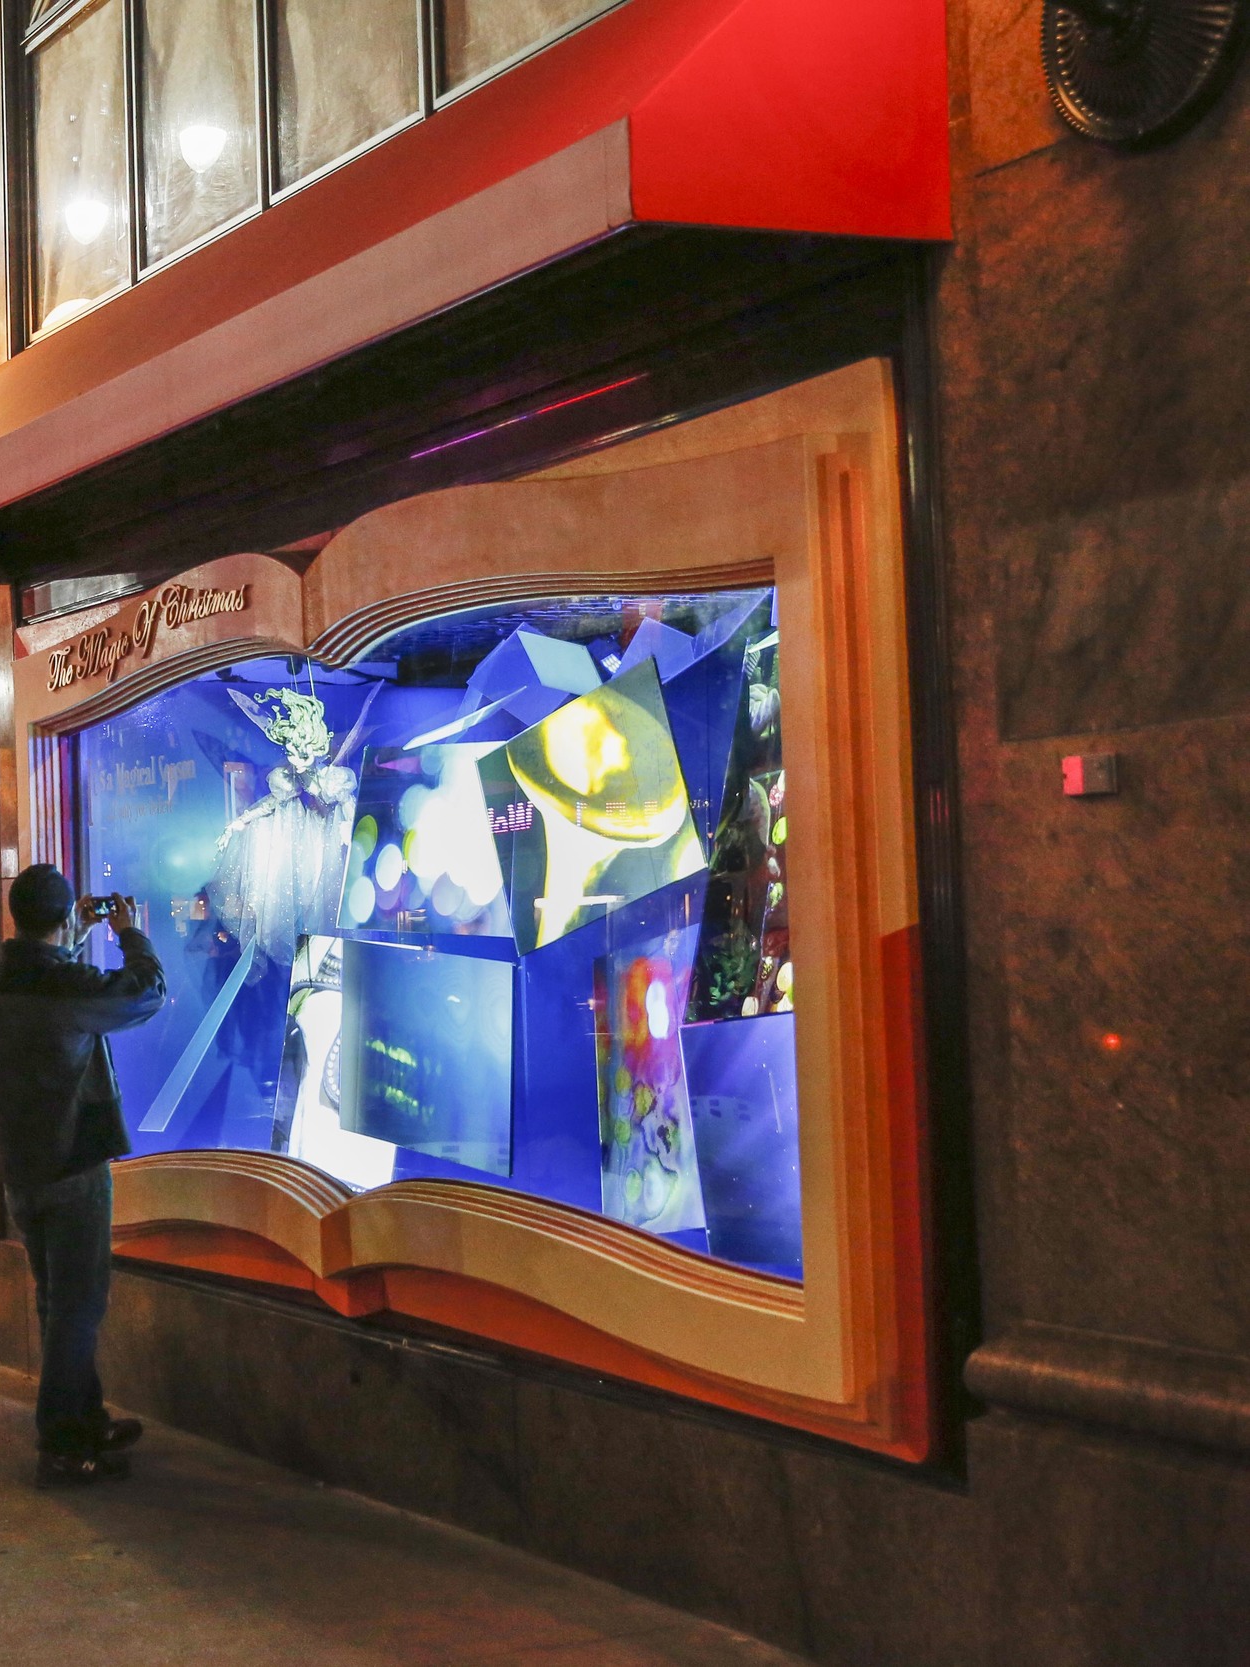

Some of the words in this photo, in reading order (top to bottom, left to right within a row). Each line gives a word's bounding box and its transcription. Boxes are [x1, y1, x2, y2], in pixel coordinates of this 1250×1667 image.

[47, 645, 73, 692] The
[76, 626, 130, 683] Magic
[132, 600, 157, 659] Of
[159, 583, 250, 630] Christmas
